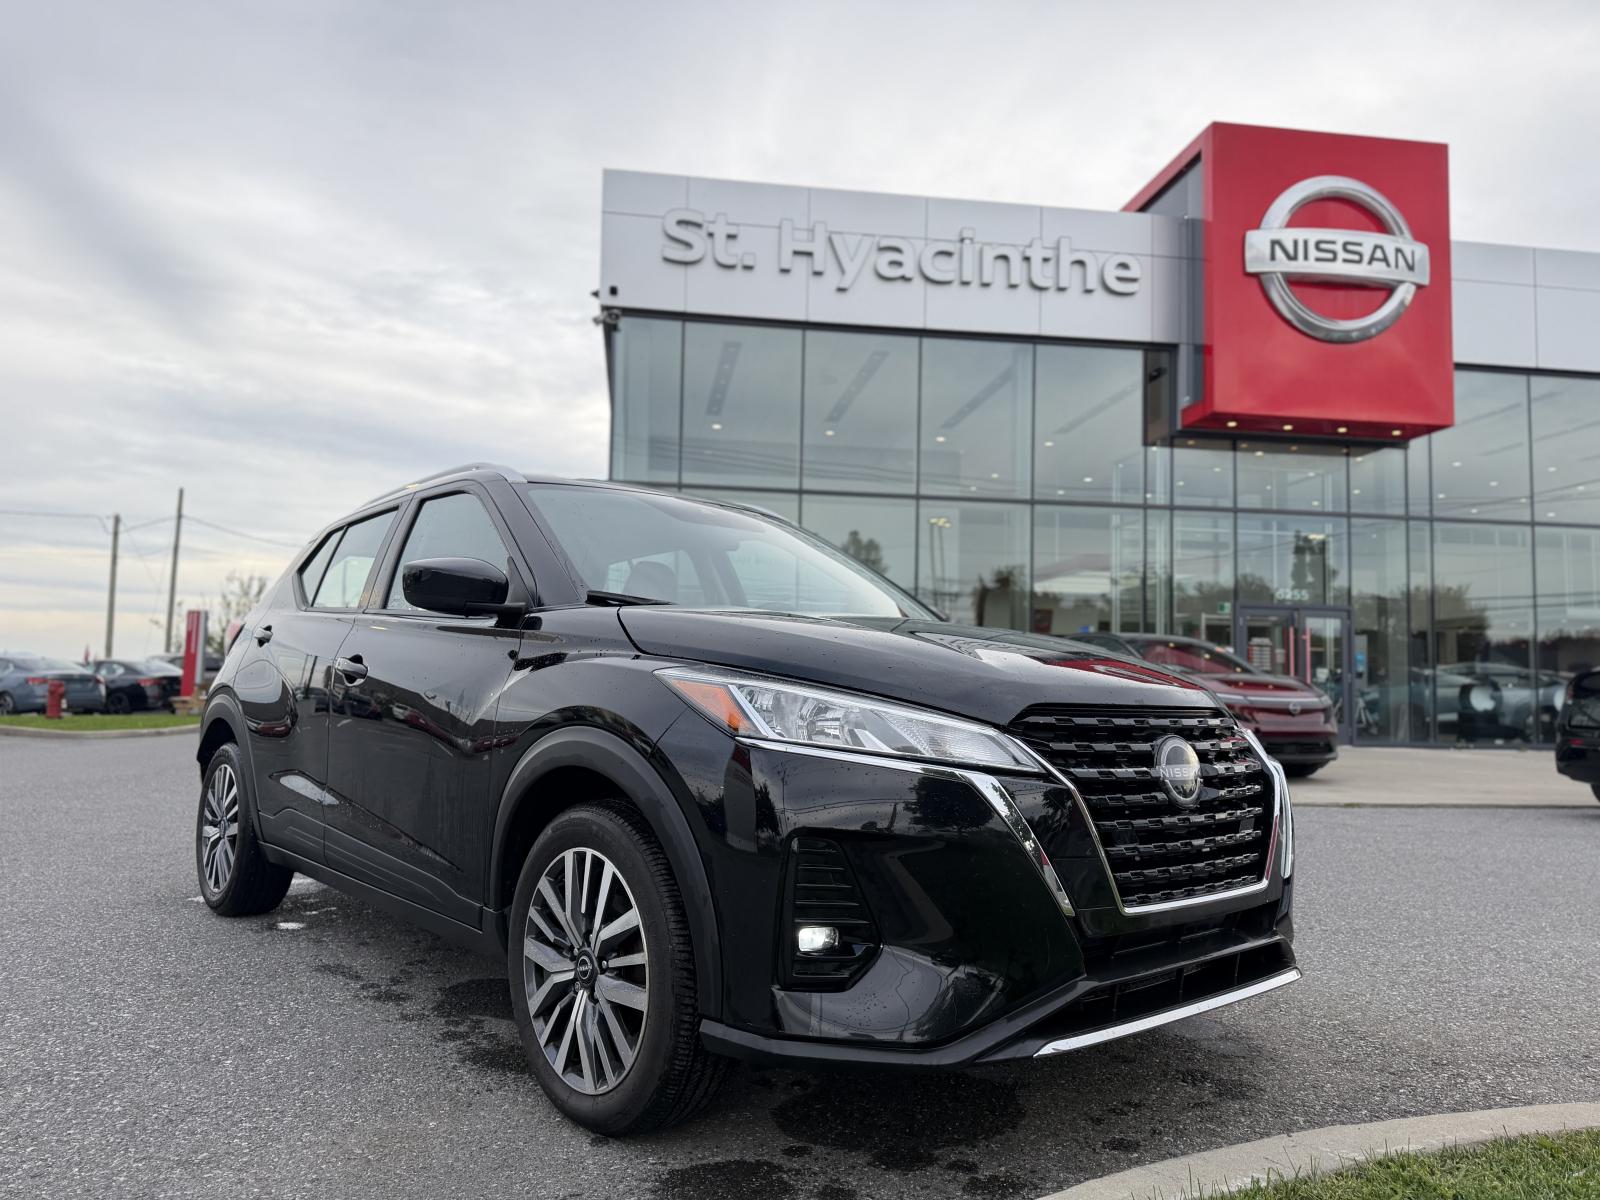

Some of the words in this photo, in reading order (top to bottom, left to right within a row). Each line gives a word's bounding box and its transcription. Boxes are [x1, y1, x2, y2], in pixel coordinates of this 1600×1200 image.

[662, 207, 756, 271] St.
[778, 217, 1142, 296] Hyacinthe
[1269, 238, 1416, 272] NISSAN
[1160, 767, 1201, 779] NISS
